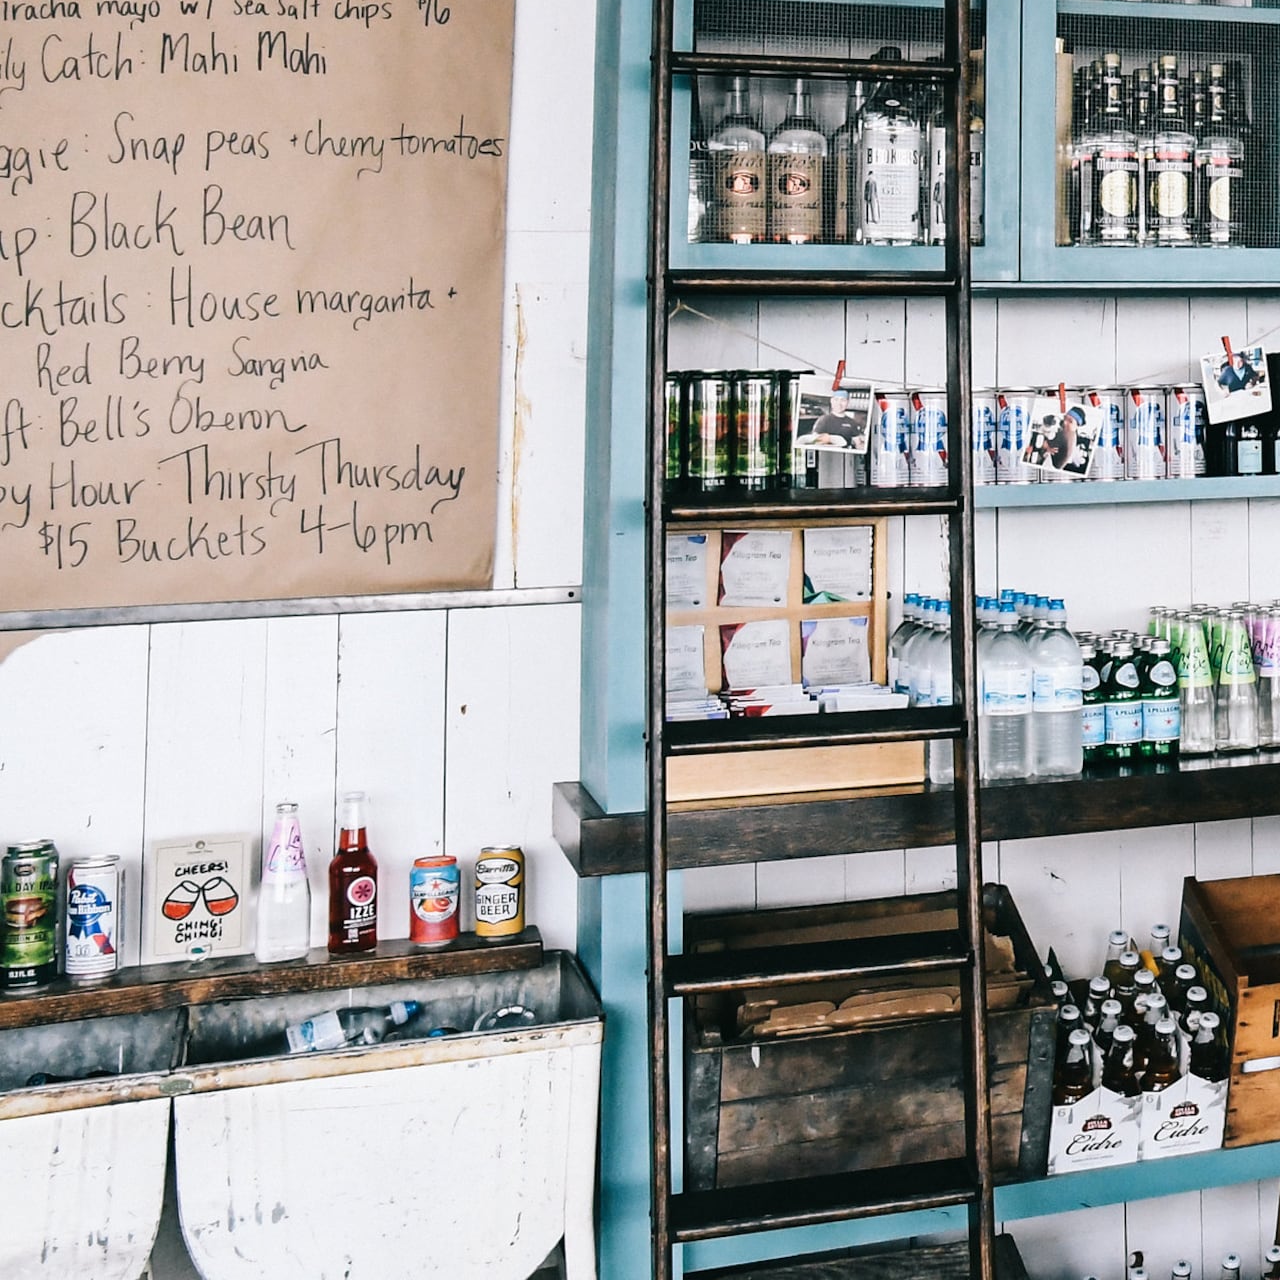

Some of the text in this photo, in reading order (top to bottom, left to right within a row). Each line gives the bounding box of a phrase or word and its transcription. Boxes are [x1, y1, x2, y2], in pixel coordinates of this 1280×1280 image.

[96, 0, 161, 30] mayo
[160, 32, 238, 76] Mahi
[257, 30, 327, 76] Mahi
[108, 112, 185, 174] Snap
[206, 129, 270, 173] peas
[392, 115, 503, 160] tomatoes
[70, 183, 296, 258] Black Bean
[169, 265, 280, 328] House
[297, 277, 434, 330] margarita
[37, 338, 92, 394] Red
[118, 336, 207, 384] Berry
[60, 397, 151, 447] Bell's
[168, 380, 307, 436] Oberon
[158, 444, 297, 517] Thirsty
[295, 438, 466, 515] Thursday
[39, 520, 90, 570] $15
[116, 514, 267, 563] Buckets
[175, 862, 229, 877] CHEERS!
[350, 903, 375, 920] IZZE
[477, 892, 517, 906] GINGER
[480, 904, 511, 917] BEER
[175, 928, 223, 944] CHING!
[177, 918, 223, 933] CHING!
[1066, 1131, 1122, 1156] Cidre
[1154, 1118, 1209, 1142] Cidre
